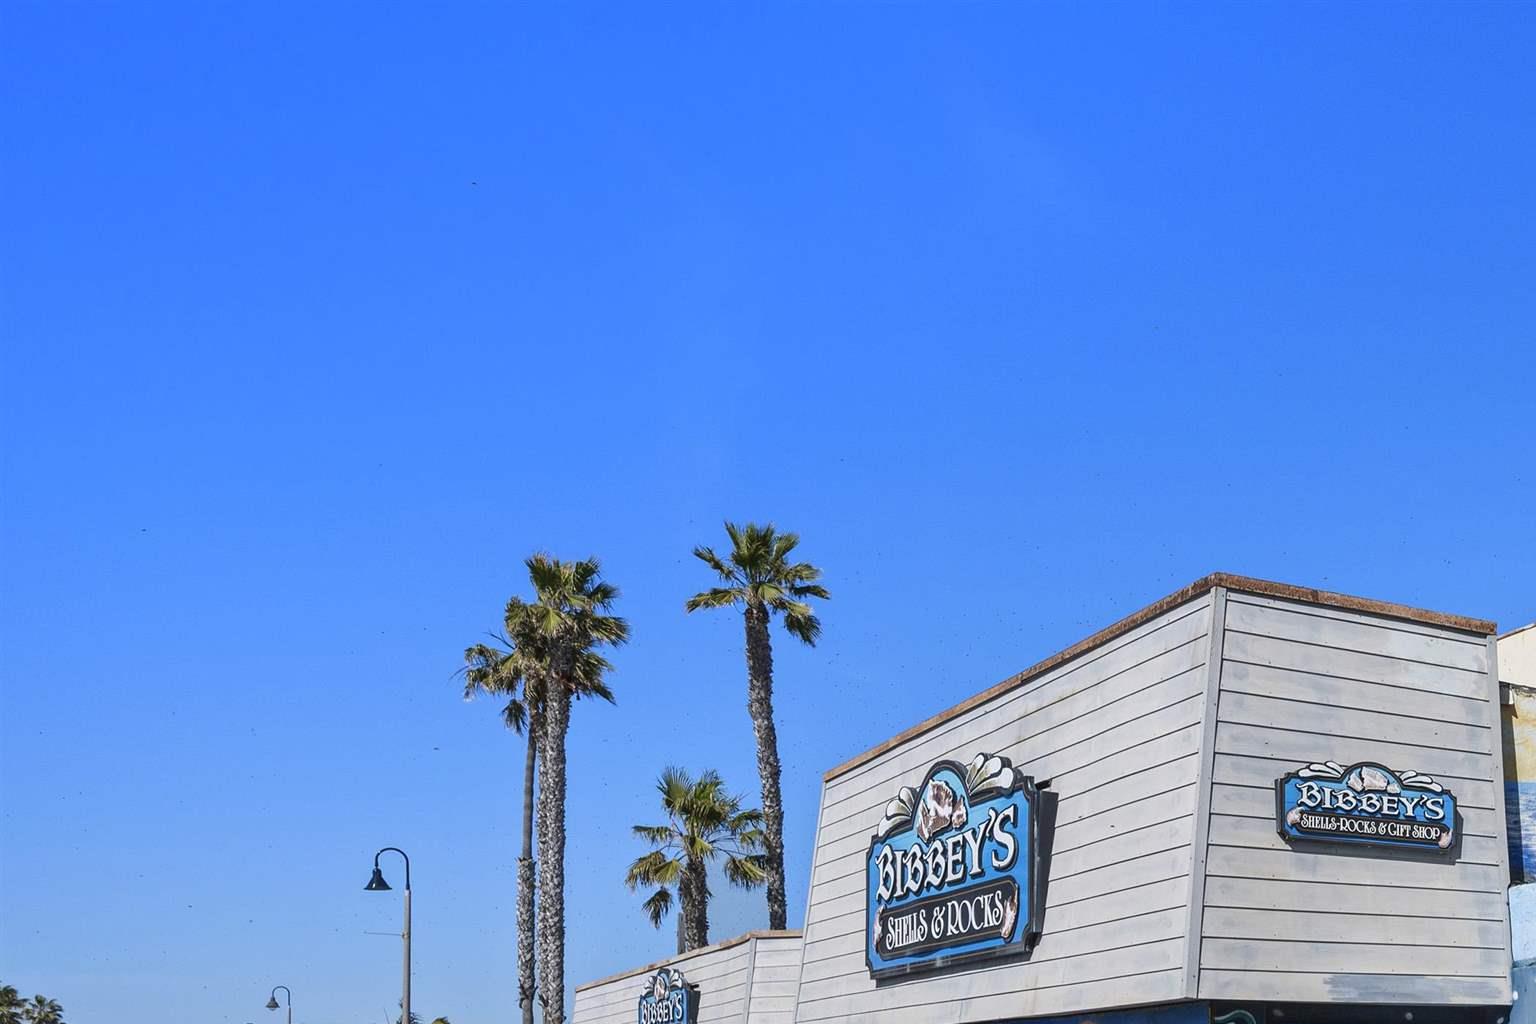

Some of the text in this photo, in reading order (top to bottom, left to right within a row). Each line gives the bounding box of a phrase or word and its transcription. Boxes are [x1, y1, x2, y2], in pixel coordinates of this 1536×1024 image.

[1296, 781, 1445, 820] BIBBEY'S
[875, 804, 1017, 902] BIBBEY'S
[1378, 823, 1388, 836] &
[1388, 822, 1412, 838] GIFT
[1412, 825, 1441, 840] SHOP
[886, 890, 1003, 950] SHELLS & ROCKS
